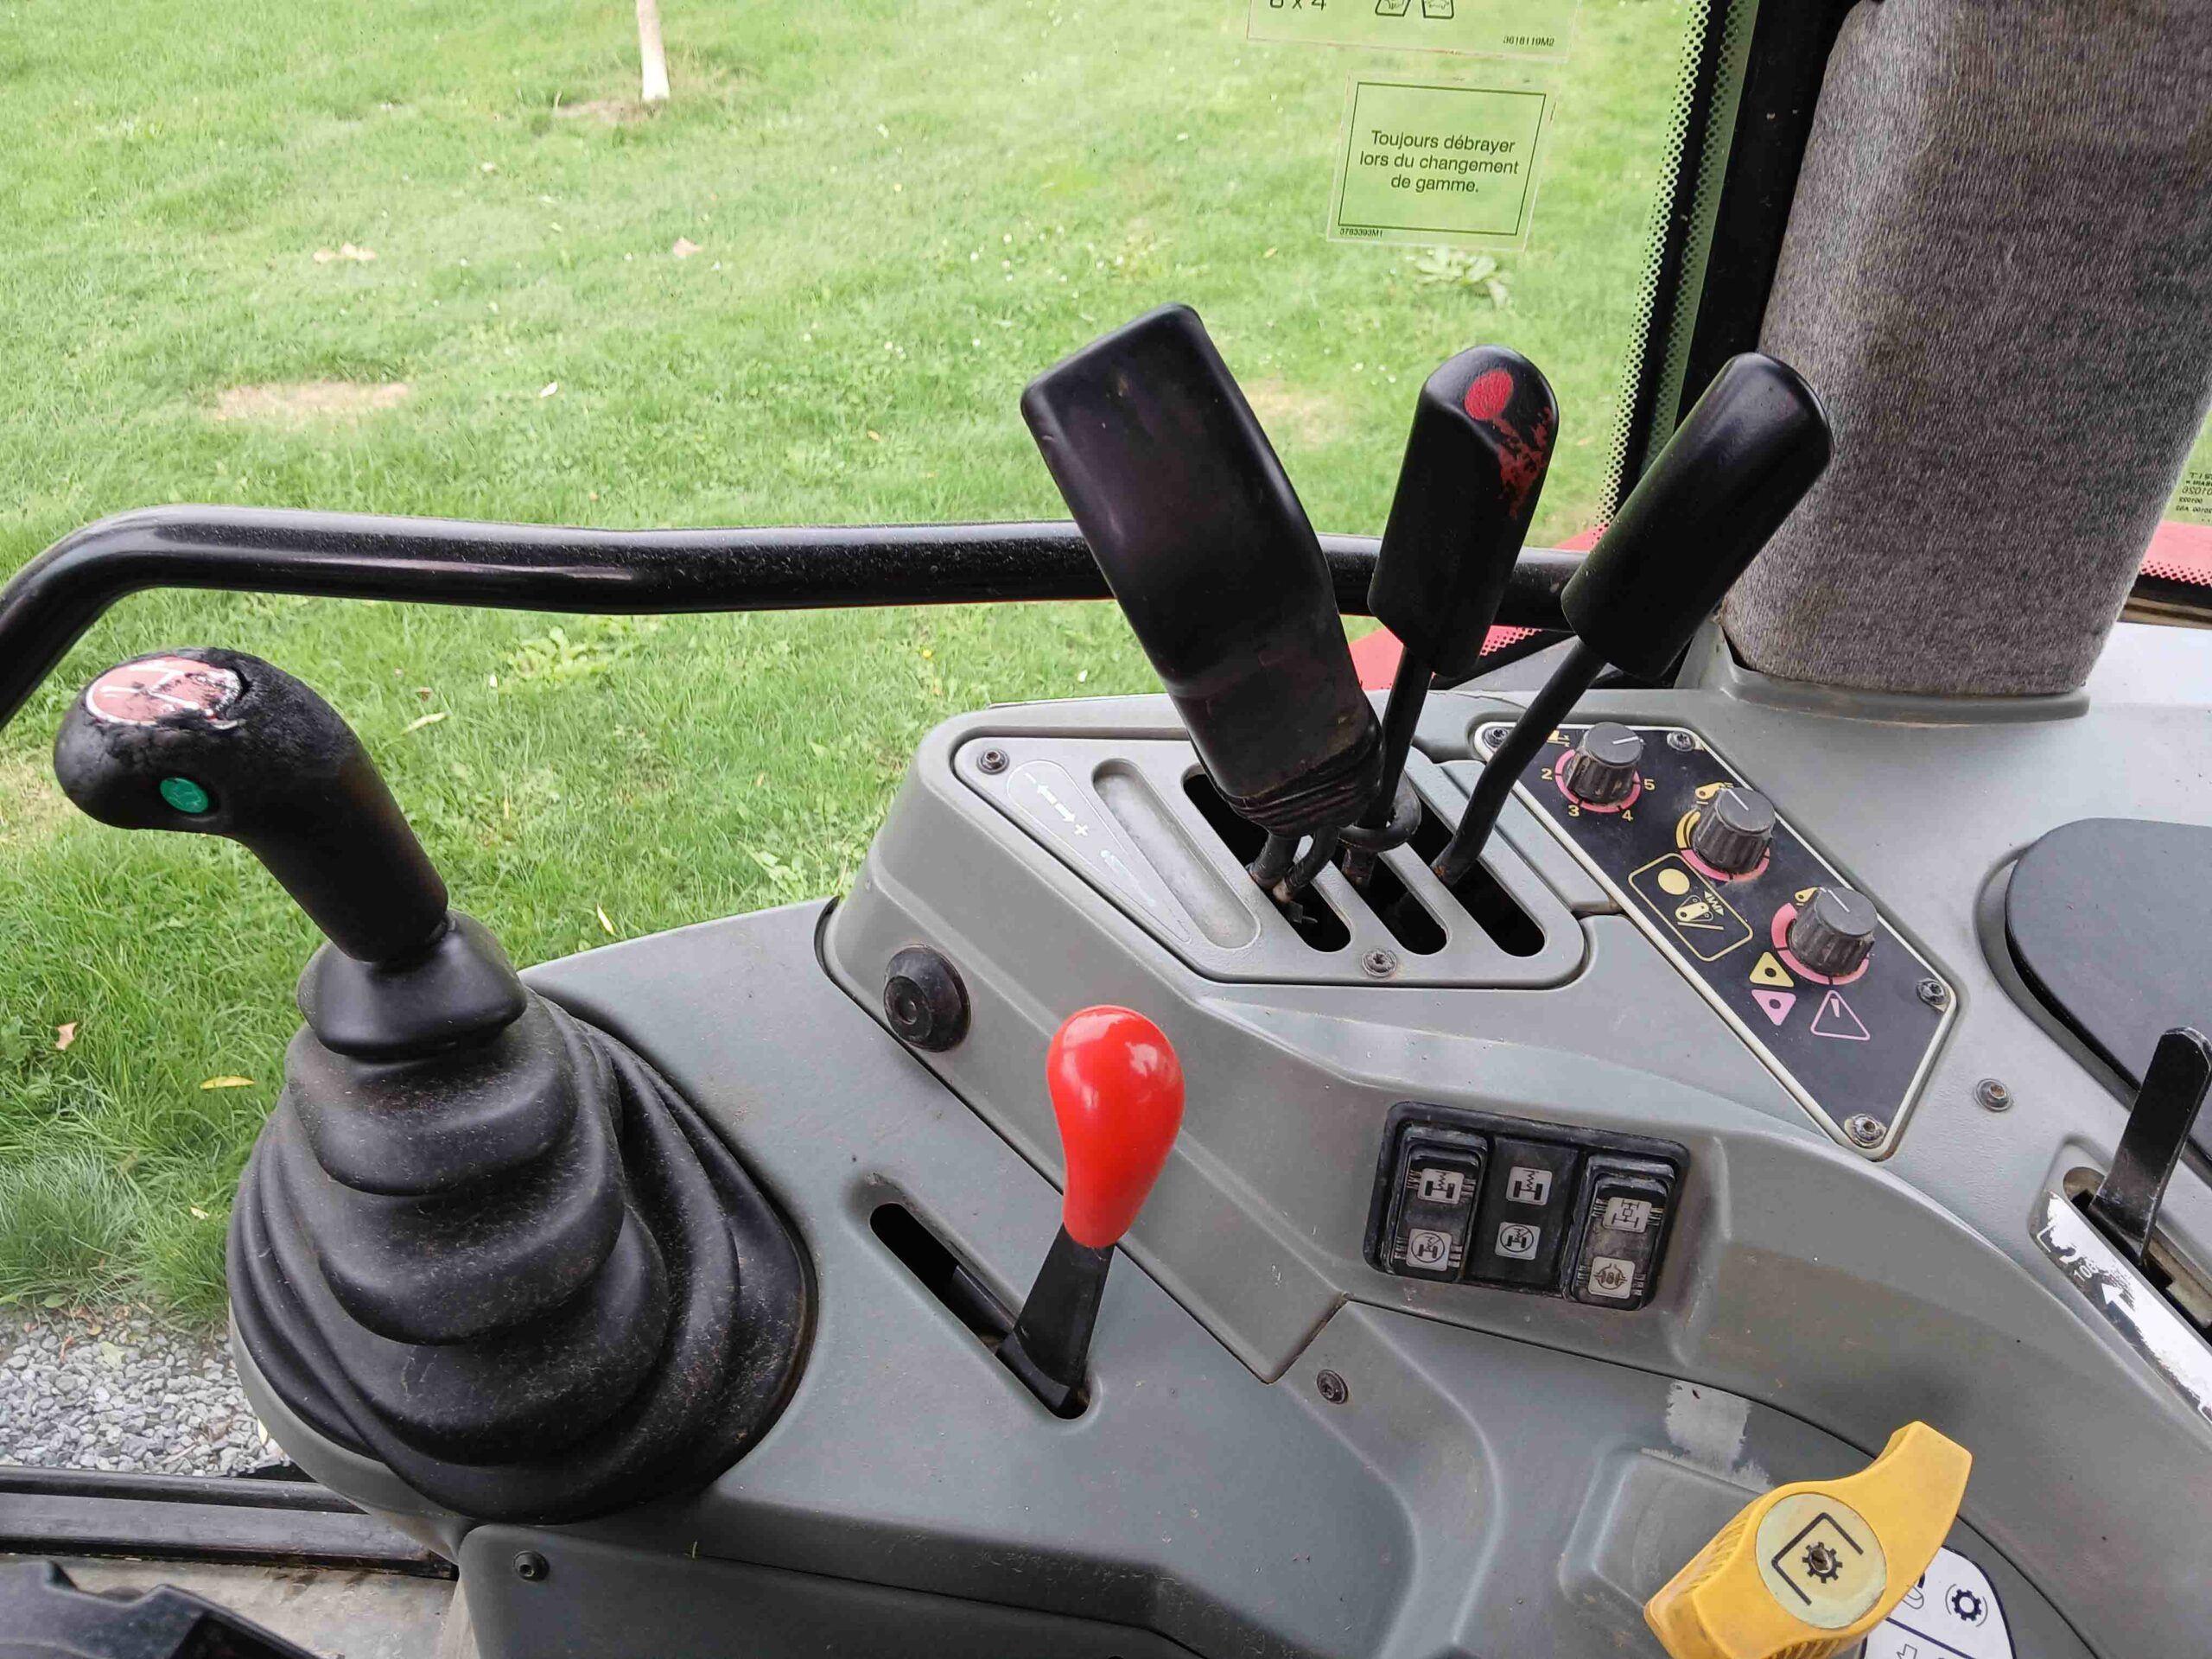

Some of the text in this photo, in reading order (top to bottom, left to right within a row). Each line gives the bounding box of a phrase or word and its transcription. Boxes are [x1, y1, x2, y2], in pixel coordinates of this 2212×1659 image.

[1371, 130, 1516, 156] Toujours débrayer
[1359, 150, 1519, 175] lors du changement
[1390, 174, 1479, 193] de gamme.
[1541, 767, 1553, 780] 2
[1643, 778, 1656, 791] 5
[1567, 804, 1580, 817] 3
[1621, 809, 1634, 822] 4
